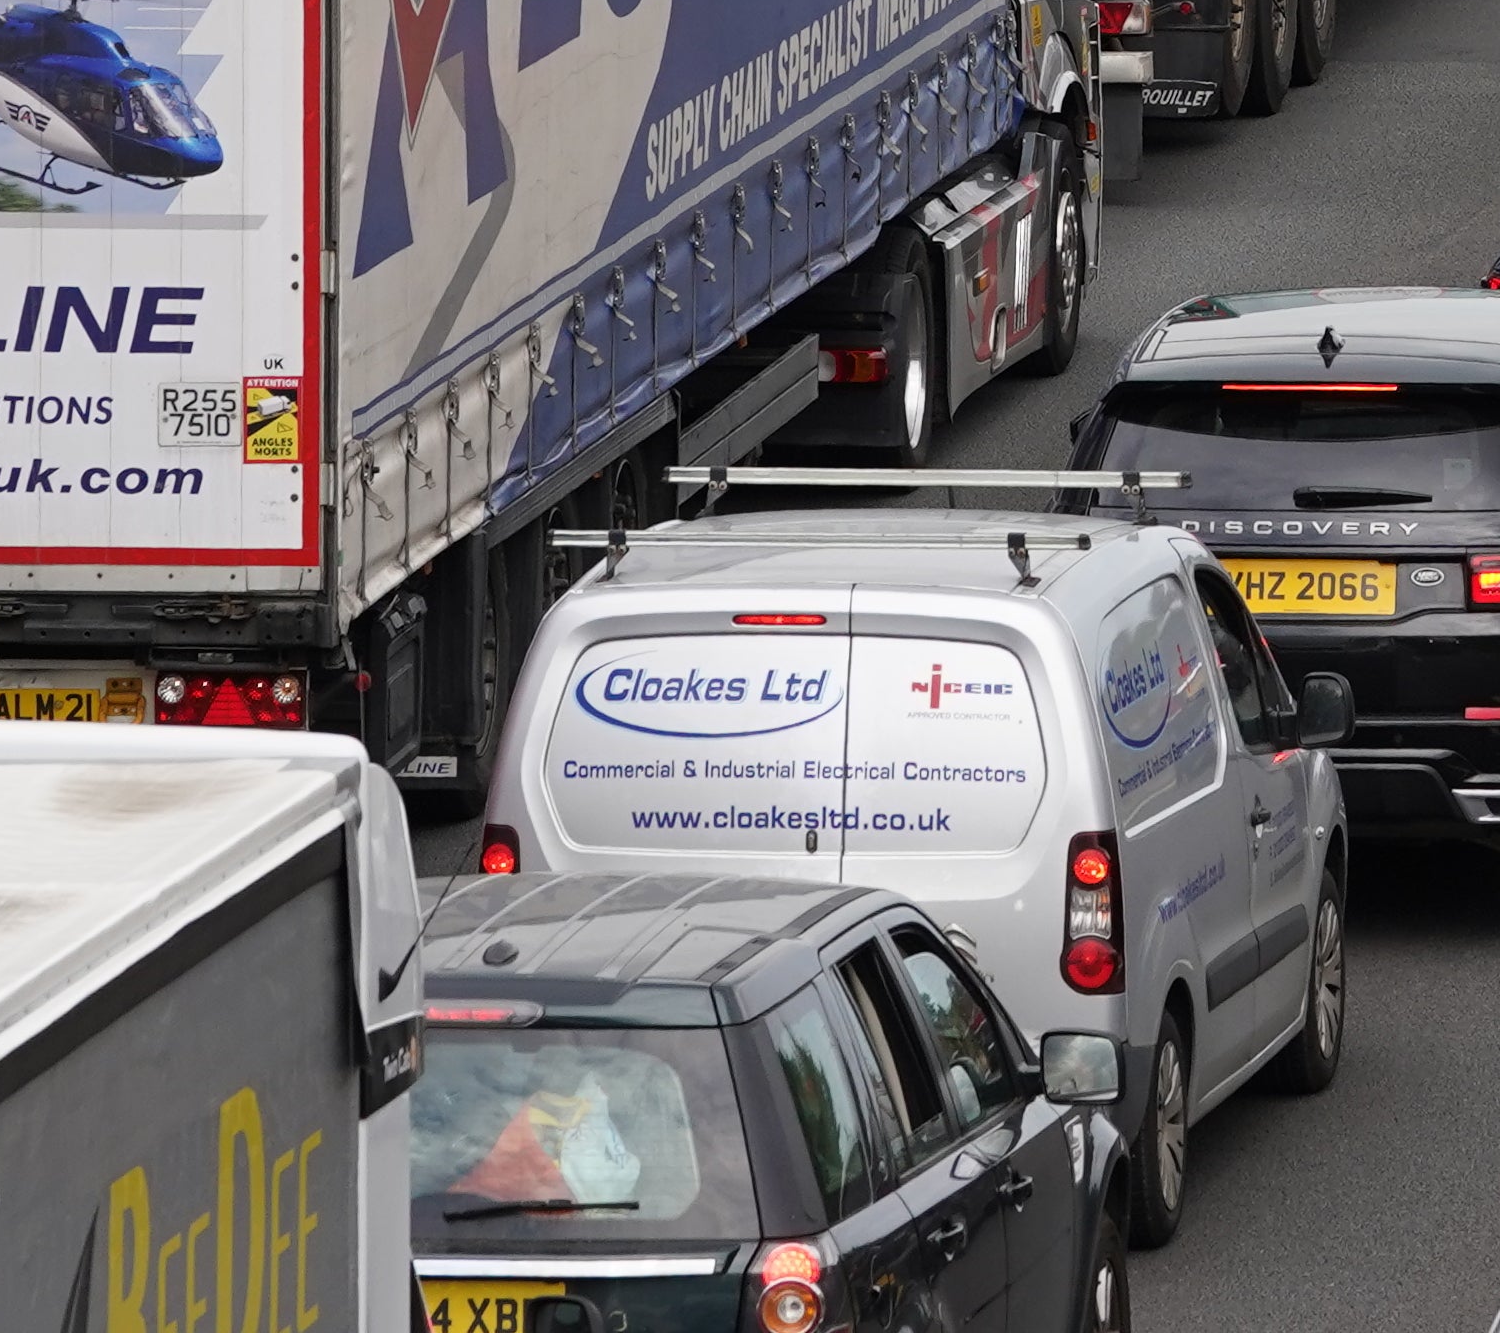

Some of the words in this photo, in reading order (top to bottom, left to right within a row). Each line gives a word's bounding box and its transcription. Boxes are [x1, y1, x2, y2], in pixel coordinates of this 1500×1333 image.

[645, 84, 716, 203] SUPPLY
[718, 48, 773, 153] CHAIN
[263, 357, 285, 371] UK
[246, 378, 299, 388] ATTENTION
[162, 388, 237, 413] R255
[169, 413, 231, 437] 7510
[251, 437, 294, 448] ANGLES
[254, 447, 292, 457] MORTS
[1181, 519, 1420, 536] DISCOVERY
[1295, 572, 1380, 602] 2066
[603, 668, 747, 703] Cloakes
[759, 668, 826, 704] Ltd
[1105, 659, 1148, 715] Cloakes
[1141, 640, 1165, 689] Ltd
[66, 692, 95, 723] 21
[907, 711, 952, 720] APPROVED
[952, 712, 1011, 721] CONTRACTOR
[563, 759, 675, 780] Commercial
[683, 760, 697, 780] &
[704, 759, 796, 781] Industrial
[802, 760, 896, 782] Electrical
[902, 762, 1027, 783] Contractors
[631, 805, 951, 833] www.cloakesltd.co.uk
[467, 1297, 530, 1333] XB
